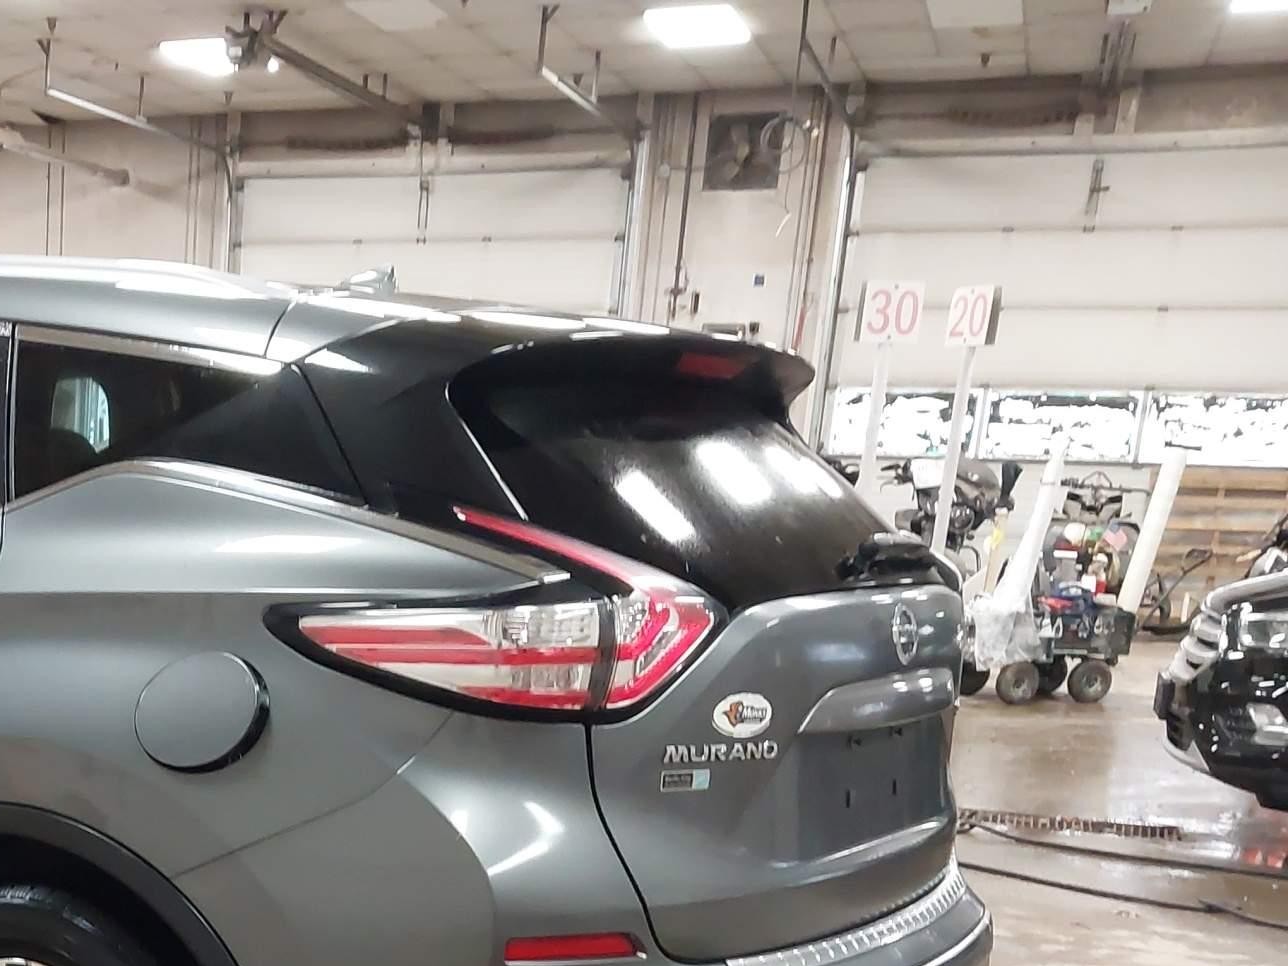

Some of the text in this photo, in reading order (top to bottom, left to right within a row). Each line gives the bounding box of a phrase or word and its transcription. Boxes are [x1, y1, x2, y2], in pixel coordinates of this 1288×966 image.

[866, 289, 919, 335] 30
[948, 293, 988, 338] 20
[663, 739, 778, 763] MURANO
